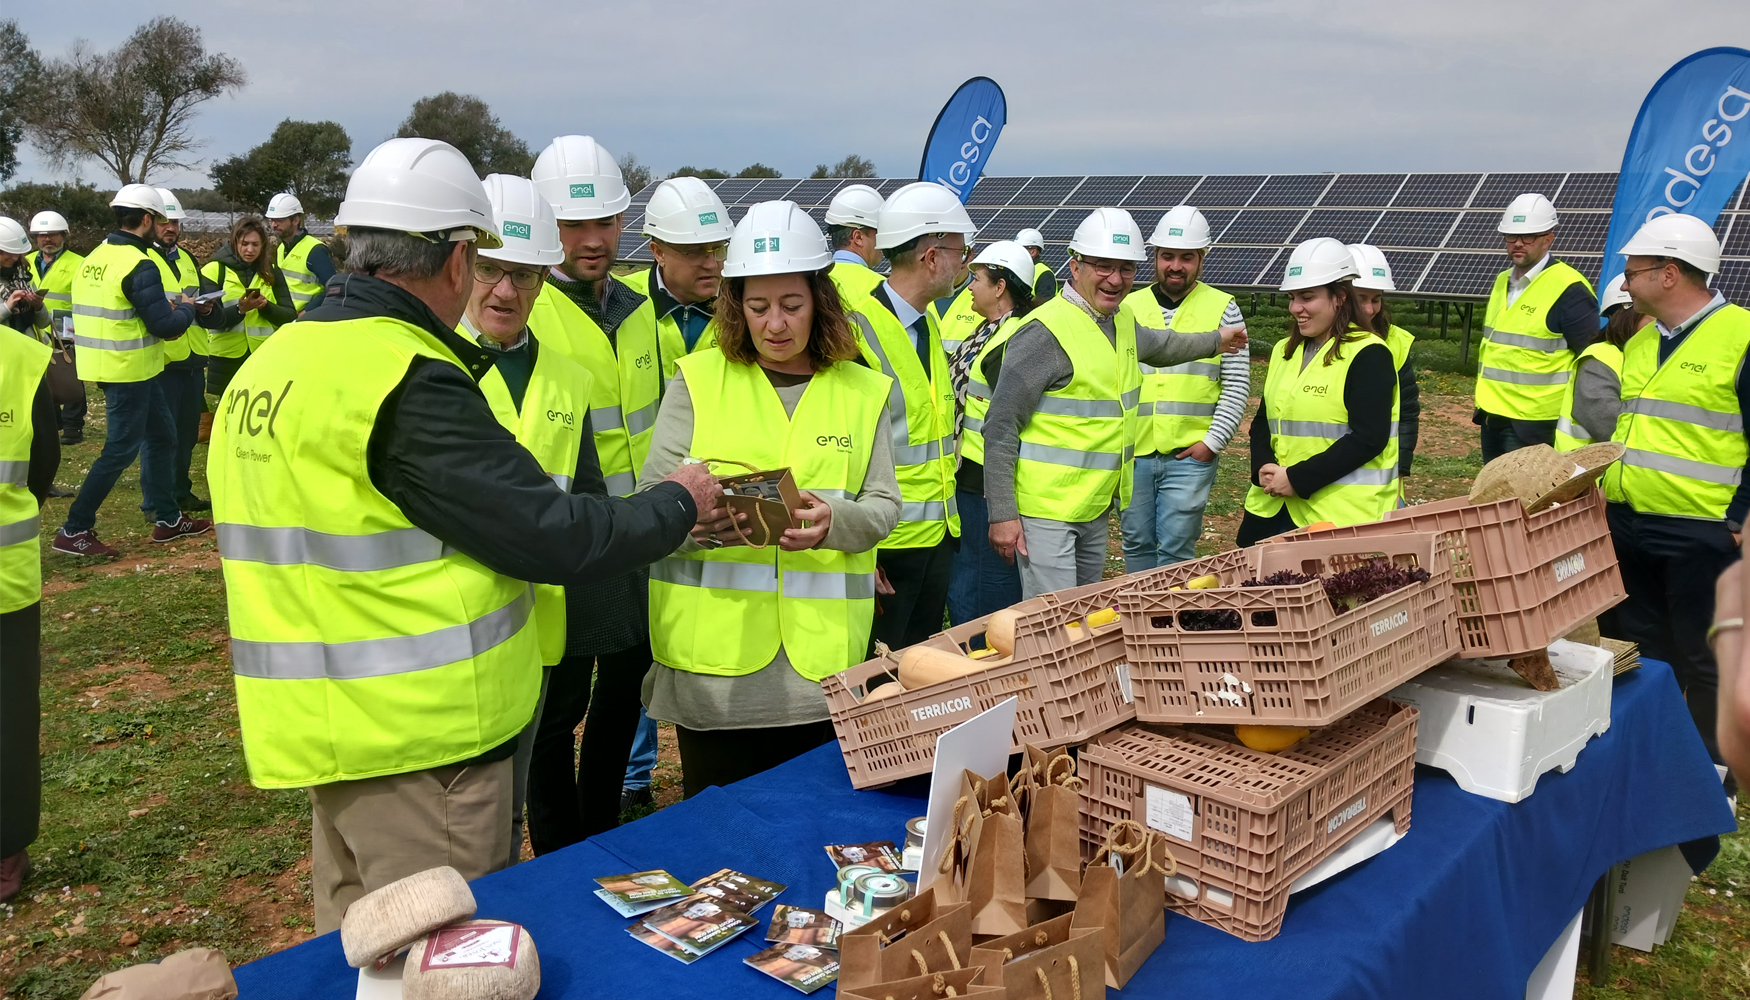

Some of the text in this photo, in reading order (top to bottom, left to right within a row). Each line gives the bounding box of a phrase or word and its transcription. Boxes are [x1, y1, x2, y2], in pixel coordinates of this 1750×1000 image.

[570, 185, 592, 194] enel
[504, 224, 528, 235] enel
[82, 264, 108, 281] enel
[635, 350, 652, 368] enel
[1680, 361, 1707, 373] enel
[1303, 384, 1329, 394] enel
[547, 409, 575, 426] enel
[816, 434, 853, 449] enel
[250, 449, 272, 463] Power
[1370, 610, 1408, 638] TERRACOR
[911, 696, 972, 722] TERRACOR
[1328, 796, 1366, 834] TERRACOR
